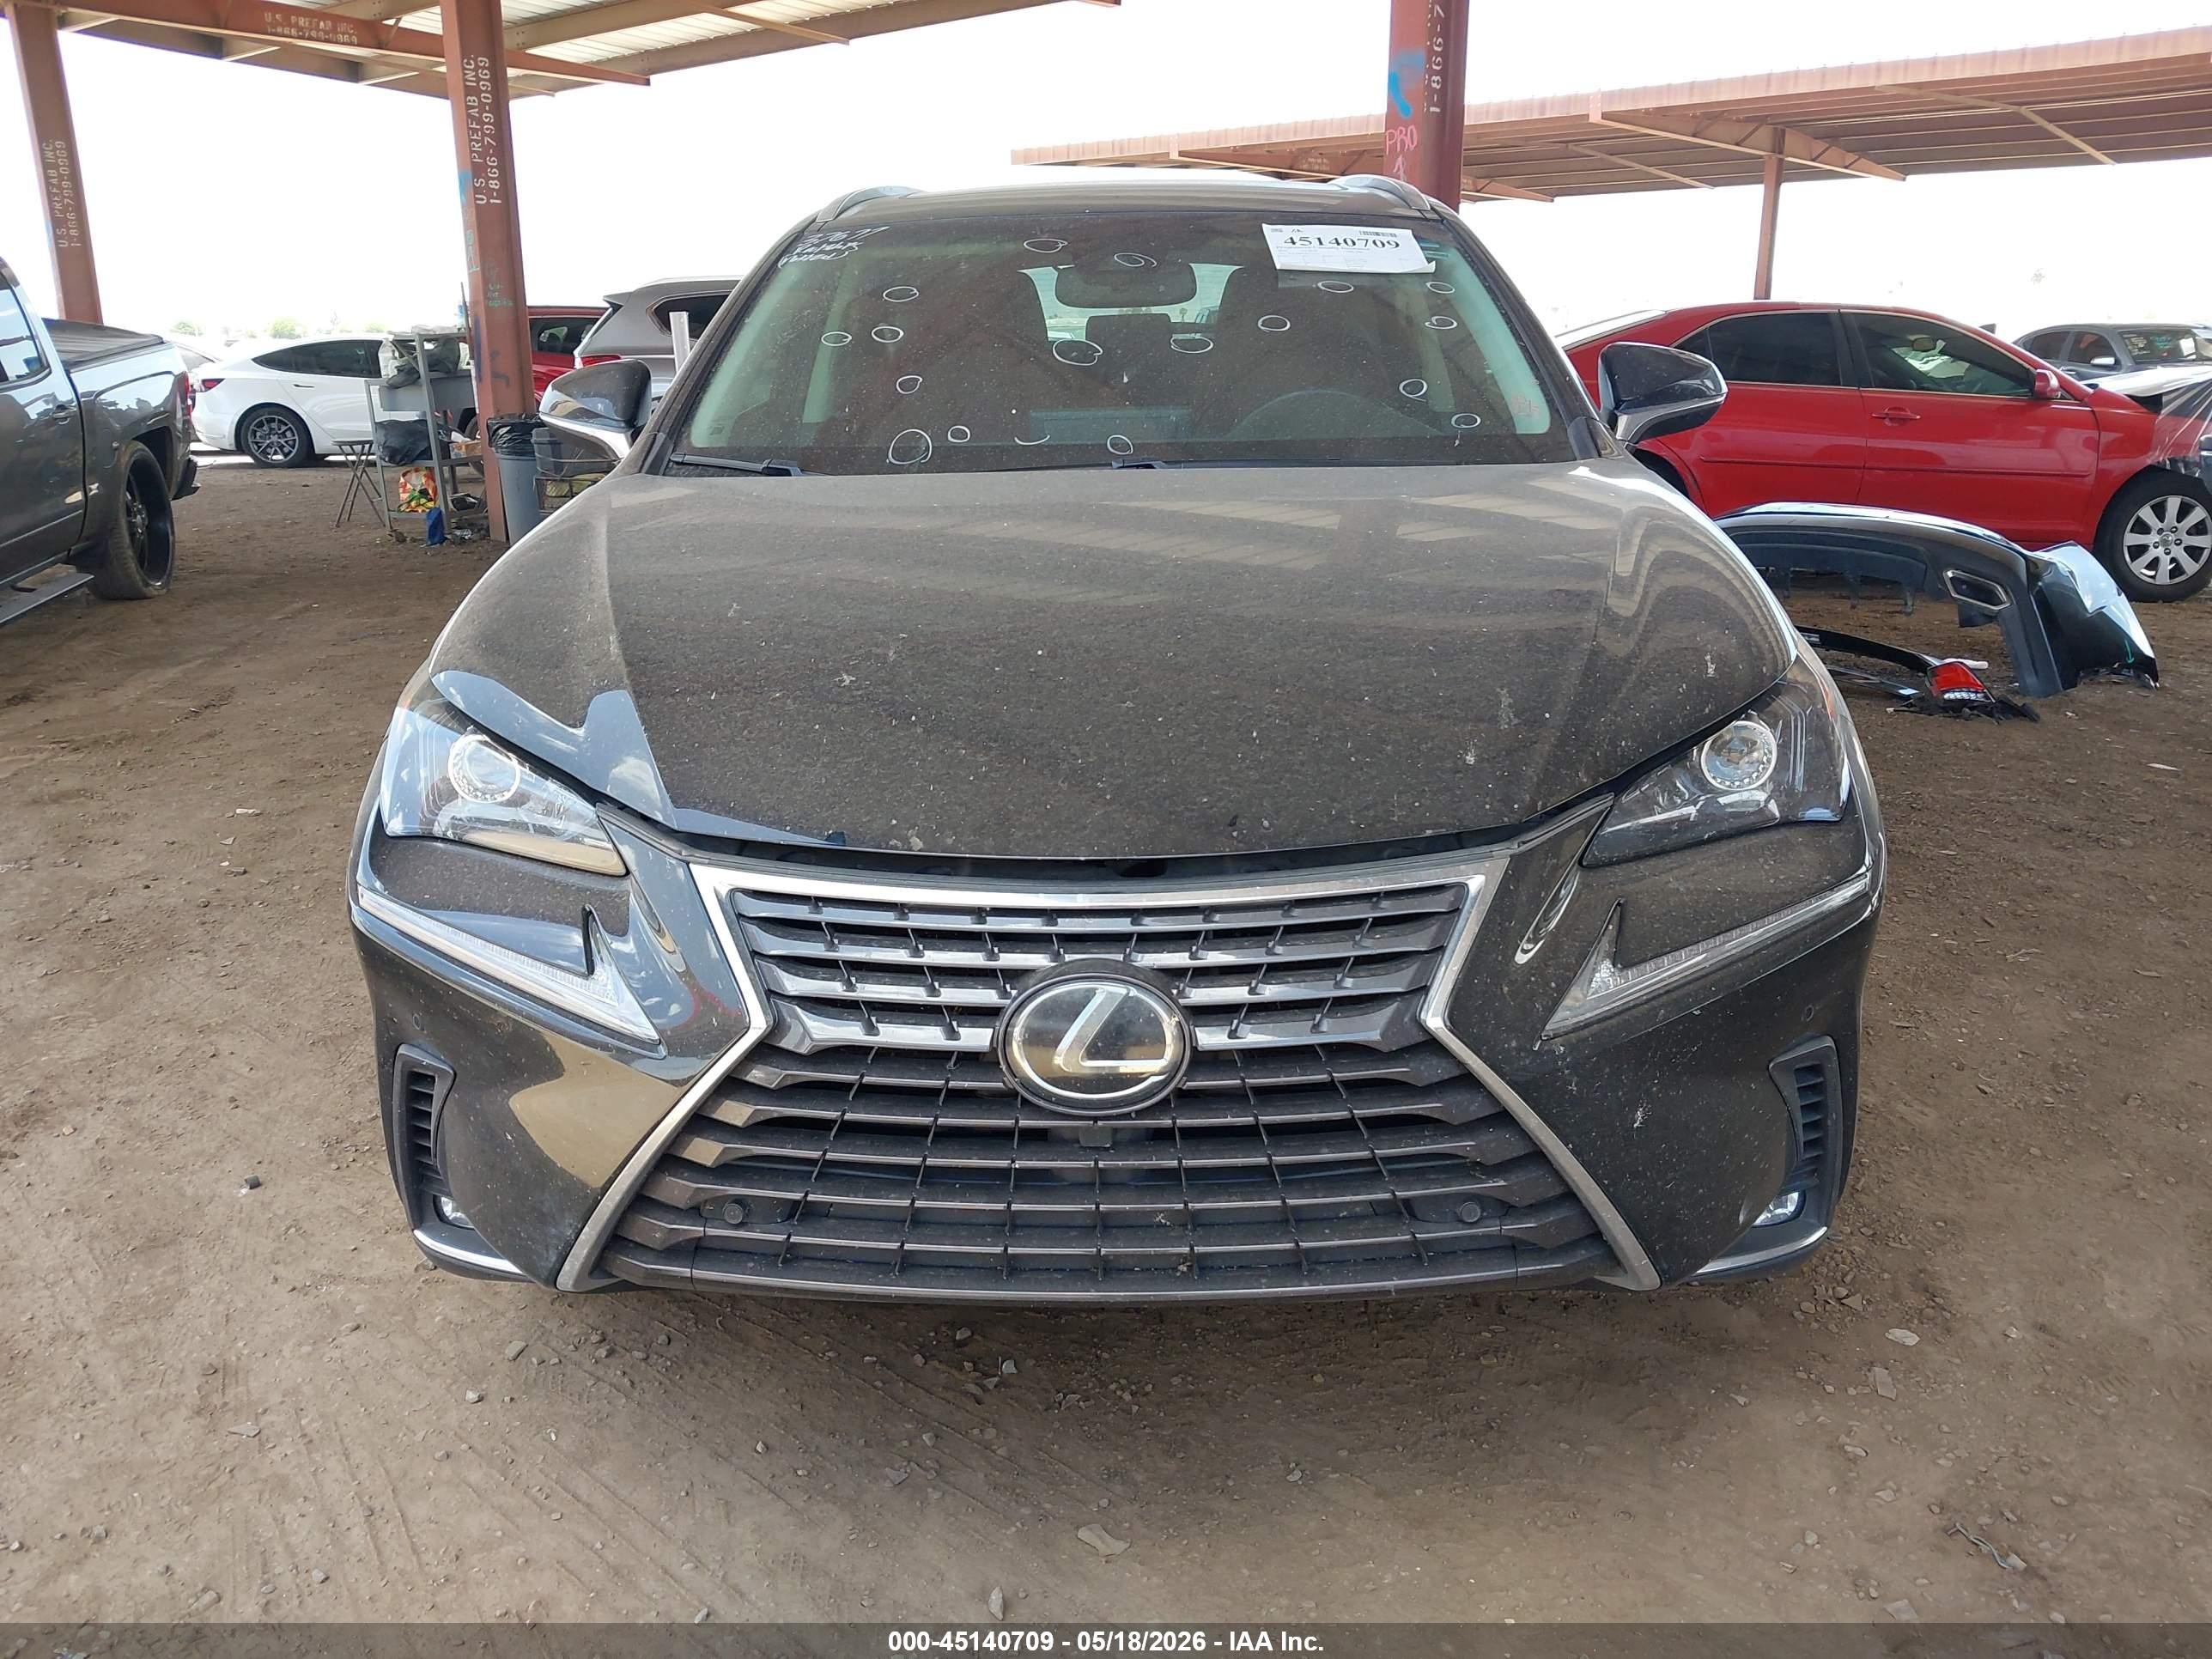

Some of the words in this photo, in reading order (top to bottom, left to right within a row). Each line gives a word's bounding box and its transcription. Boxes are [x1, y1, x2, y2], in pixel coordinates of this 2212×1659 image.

[290, 15, 332, 30] PREFAB
[463, 54, 477, 87] INC.
[466, 95, 483, 162] PREFAB
[477, 57, 502, 204] 1-866-799-0969
[1386, 124, 1418, 155] PRO
[41, 138, 57, 163] INC.
[46, 169, 65, 217] PREFAB
[54, 140, 82, 247] 1-866-799-0969
[473, 173, 488, 204] U.S.
[56, 224, 69, 247] U.S.
[1284, 235, 1401, 250] 45140709
